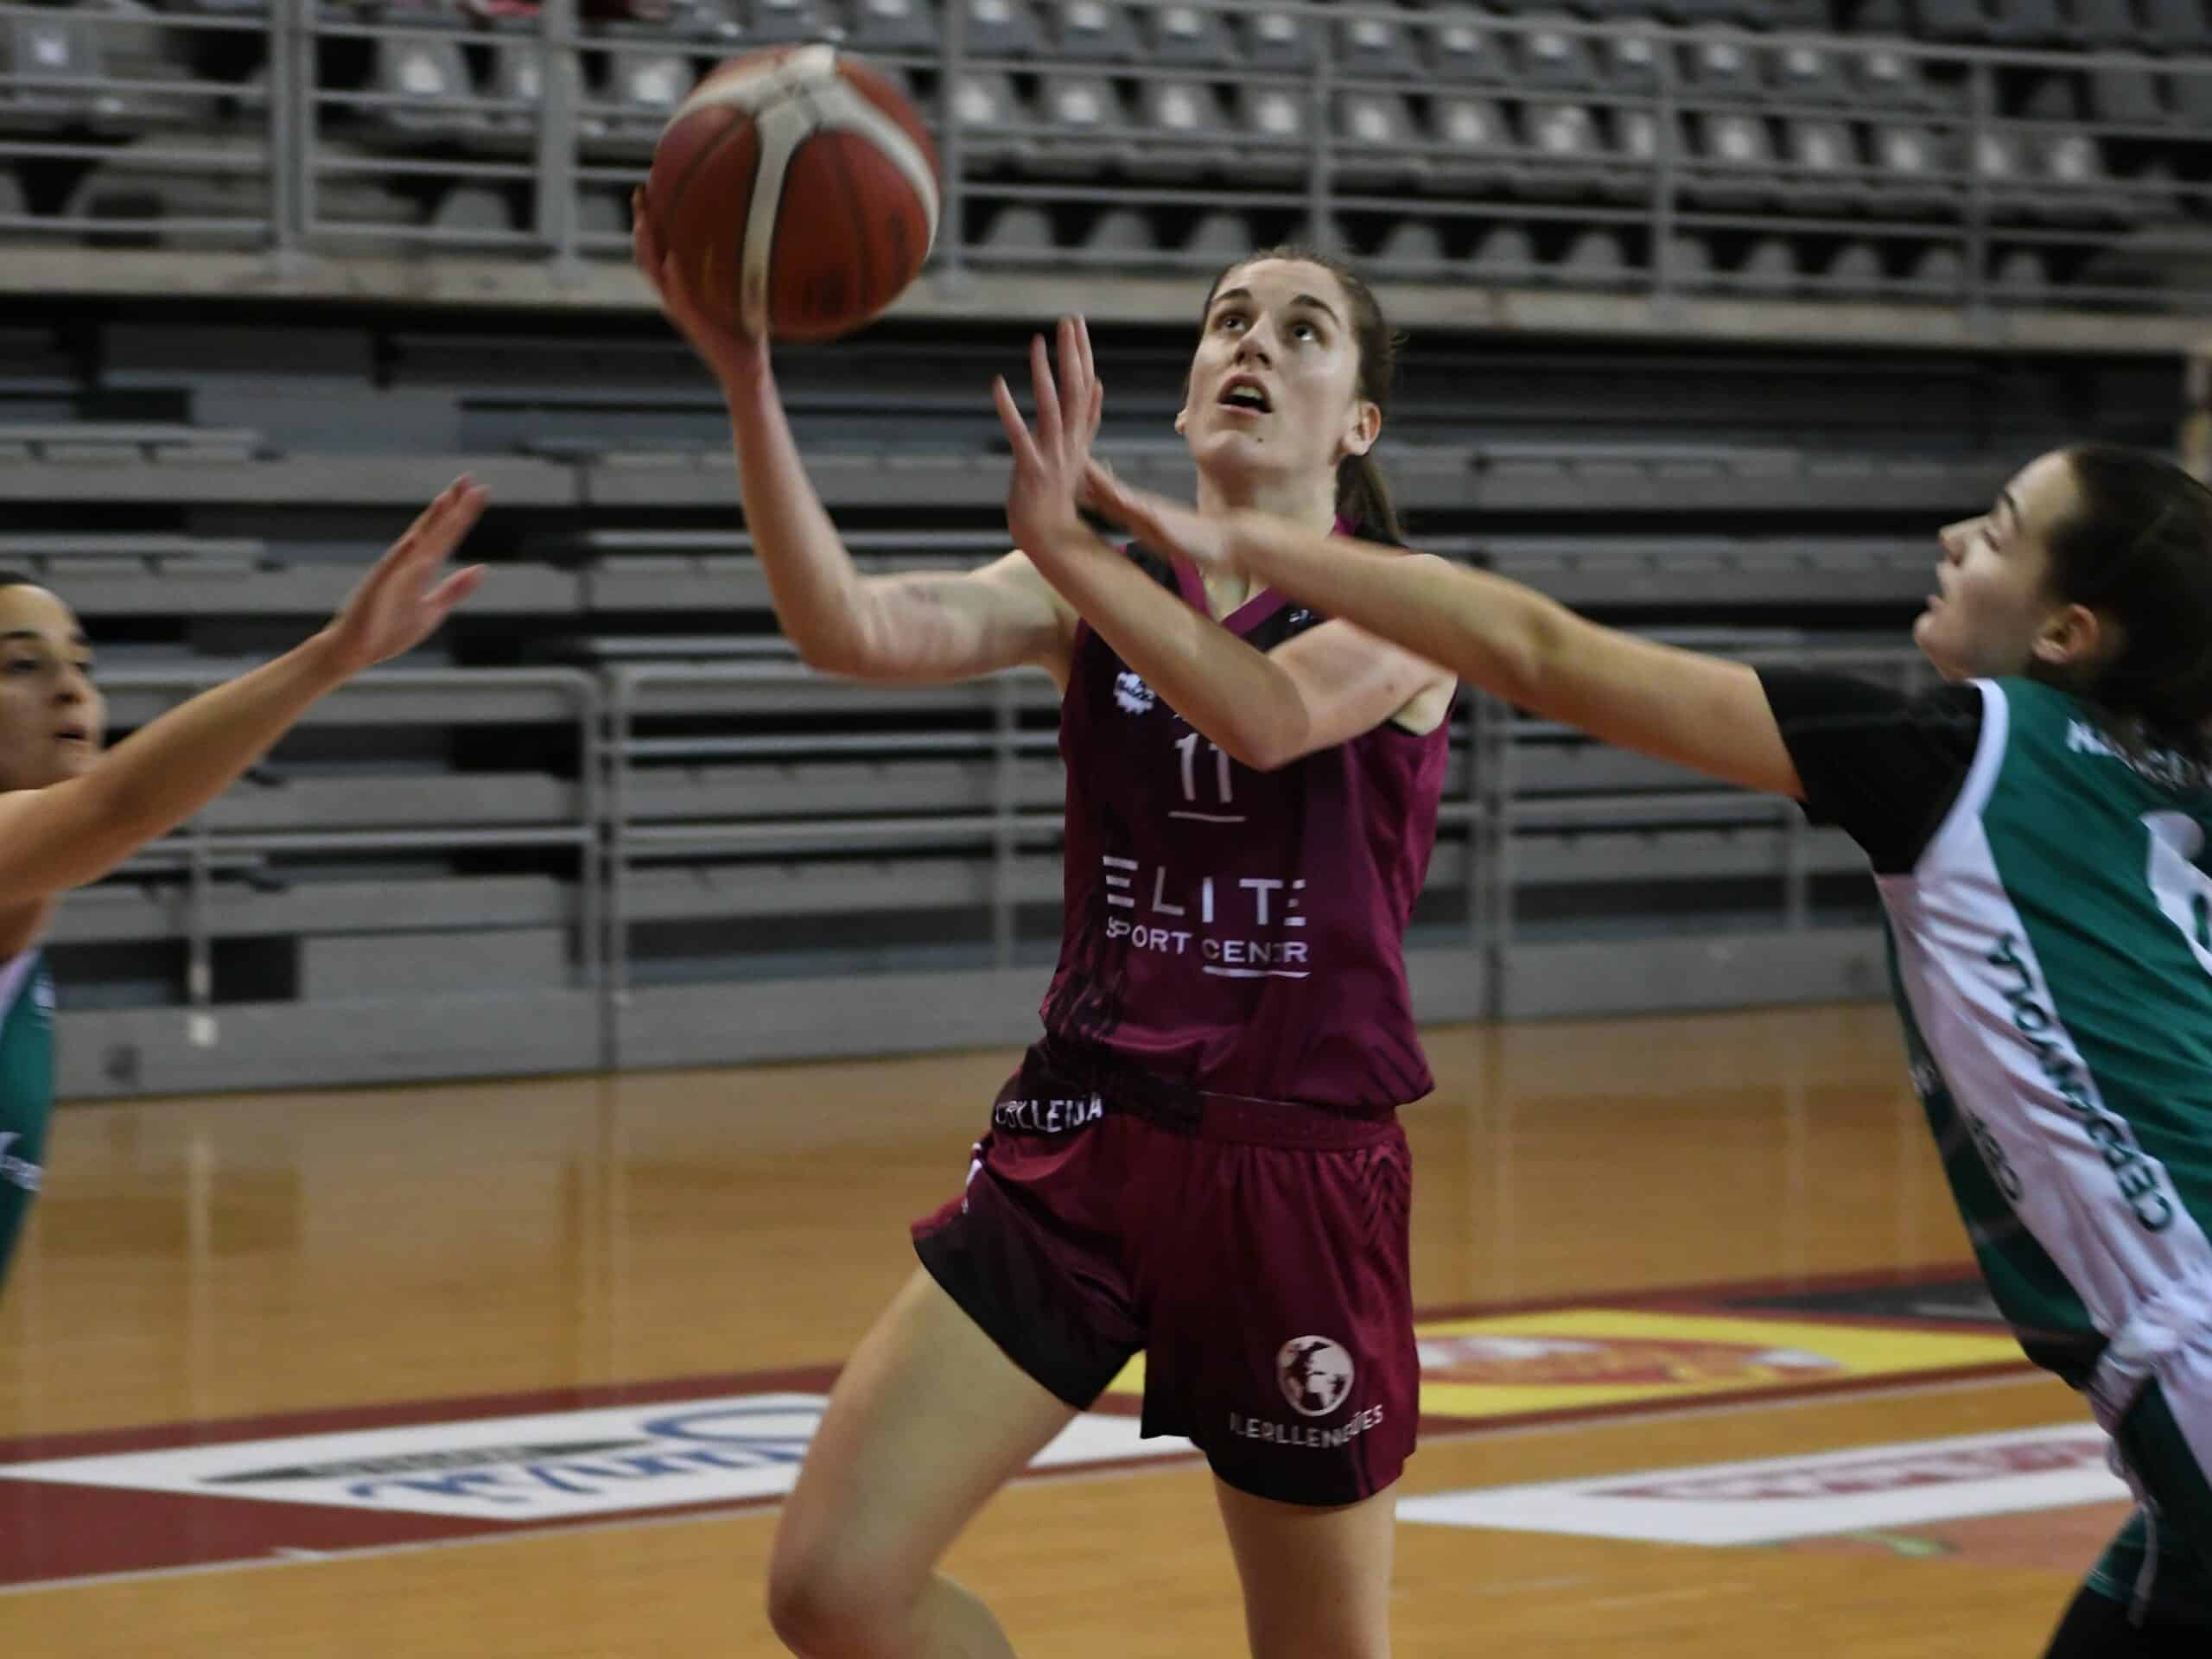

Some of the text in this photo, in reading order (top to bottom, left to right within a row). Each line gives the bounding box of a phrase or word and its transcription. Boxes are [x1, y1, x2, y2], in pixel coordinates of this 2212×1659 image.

[1174, 732, 1233, 804] 11
[1103, 855, 1306, 927] ELITE
[1105, 915, 1309, 963] SPORT CENR
